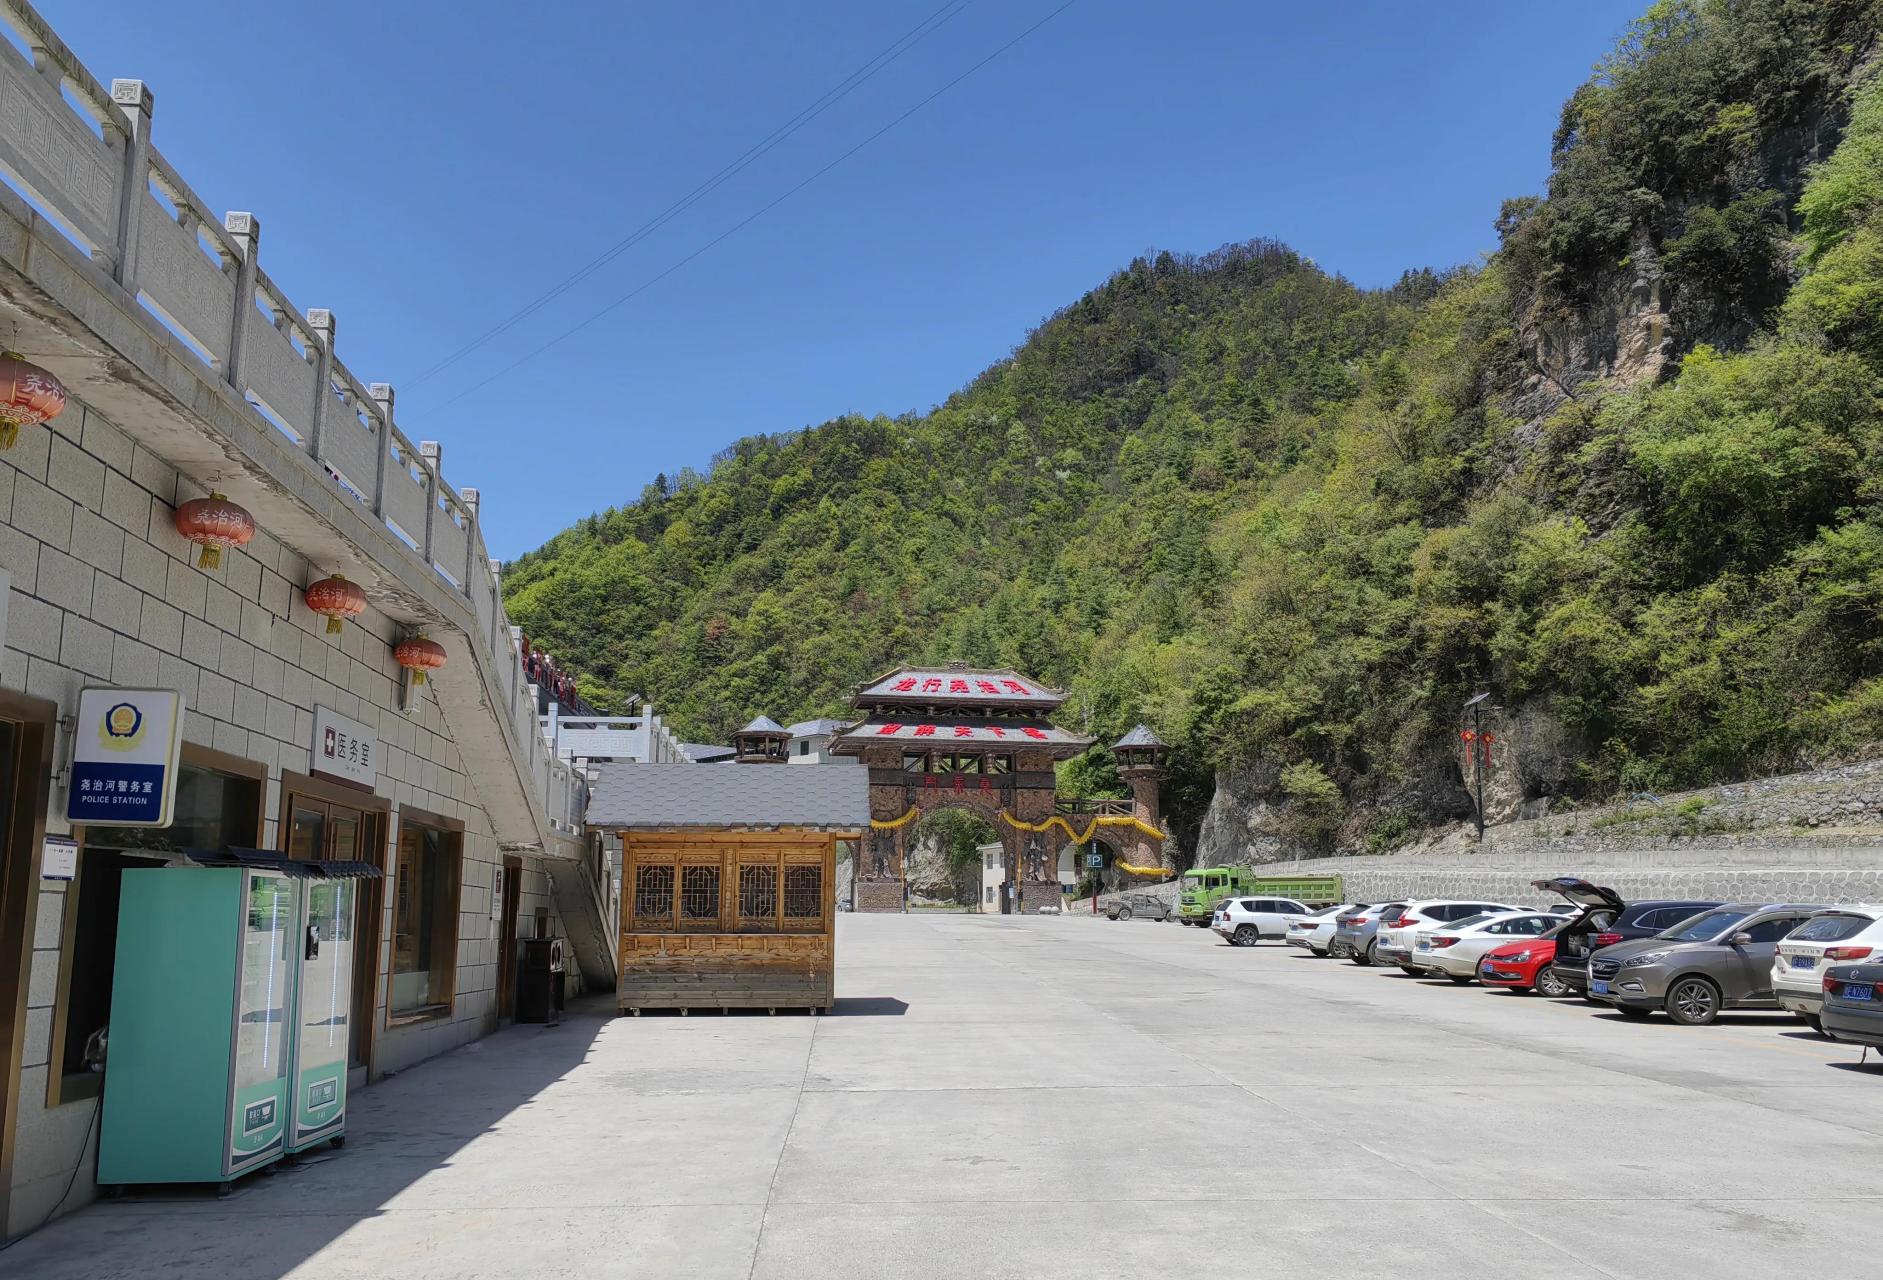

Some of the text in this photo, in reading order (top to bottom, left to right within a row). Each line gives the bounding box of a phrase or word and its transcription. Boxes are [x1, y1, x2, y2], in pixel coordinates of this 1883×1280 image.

[890, 677, 1031, 696] 龙行尧治河
[337, 733, 370, 767] 医务室
[80, 779, 153, 793] 尧治河警务室
[82, 795, 147, 805] POLICE STATION
[1092, 856, 1101, 866] P
